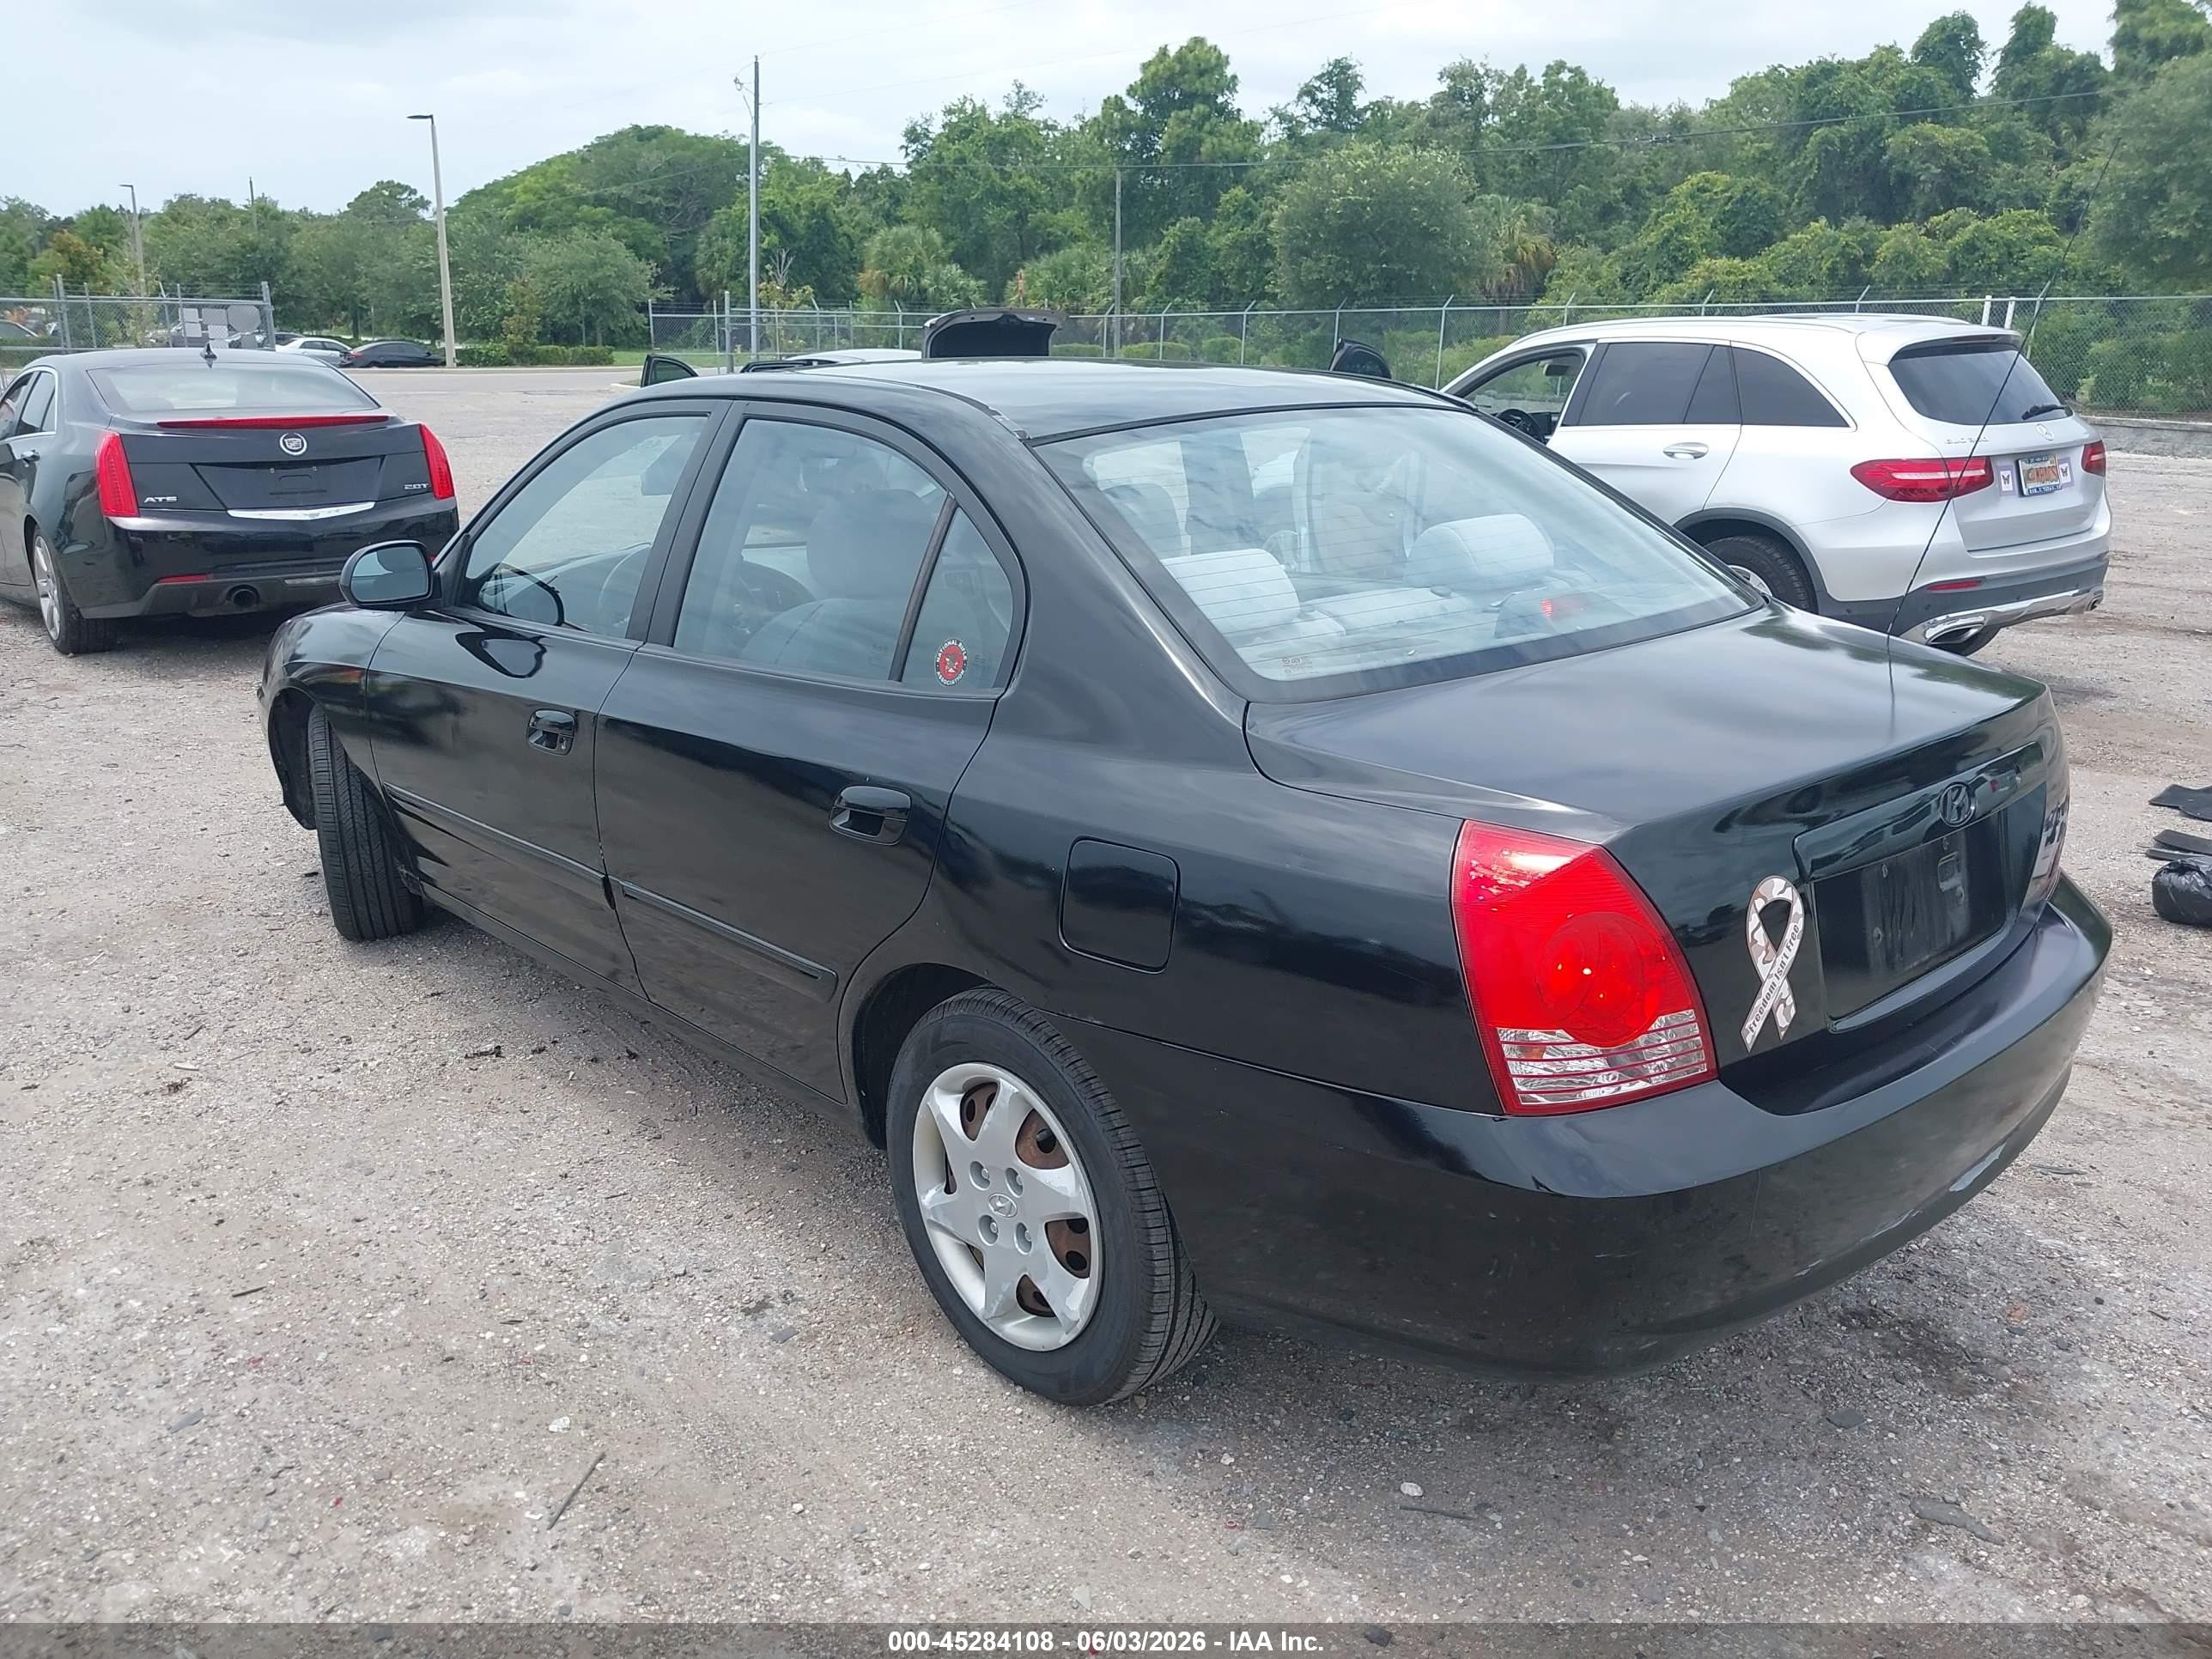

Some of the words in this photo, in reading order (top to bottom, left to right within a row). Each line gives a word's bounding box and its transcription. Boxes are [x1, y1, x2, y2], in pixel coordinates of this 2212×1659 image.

[936, 639, 957, 663] NATIONAL
[957, 641, 968, 661] RIFLE
[936, 668, 965, 686] ASSOCIATION
[1747, 980, 1778, 1034] Freedom
[1774, 953, 1789, 981] Isn't
[1786, 924, 1801, 954] Free
